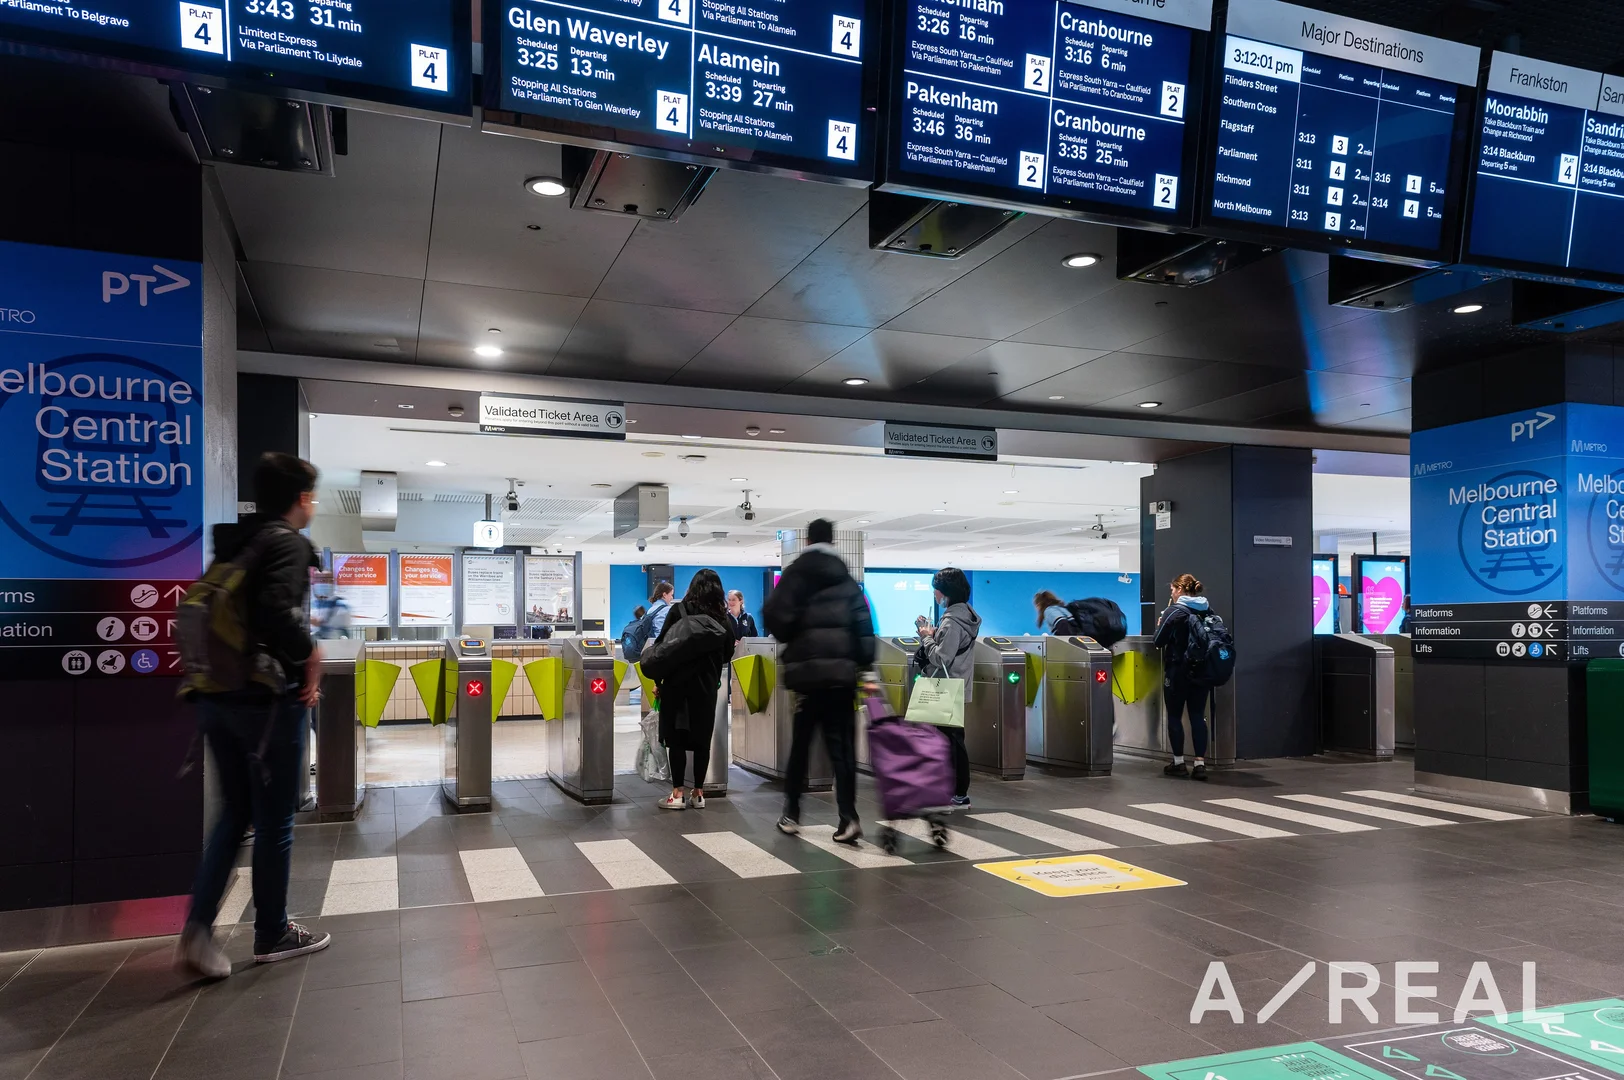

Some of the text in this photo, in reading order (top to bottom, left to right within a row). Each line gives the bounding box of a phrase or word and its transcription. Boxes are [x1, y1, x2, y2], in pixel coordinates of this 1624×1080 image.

[65, 7, 79, 18] To
[82, 10, 129, 27] Belgrave
[189, 8, 213, 20] PLAT
[246, 0, 361, 32] 3:43 31 min
[194, 22, 211, 45] 4
[239, 25, 317, 47] Limited Express
[508, 7, 669, 60] Glen Waverley
[1060, 12, 1152, 46] Cranbourne
[840, 31, 852, 50] 4
[1301, 21, 1424, 63] Major Destinations
[240, 38, 362, 67] Via Parliament To Lilydale
[698, 44, 780, 76] Alamein
[1233, 48, 1293, 74] 3:12:01 pm
[423, 63, 438, 83] 4
[518, 48, 614, 81] 3:25 13 min
[512, 77, 597, 98] Stopping All Stations
[1225, 75, 1277, 94] Flinders Street
[1510, 68, 1567, 93] Frankston
[512, 88, 640, 118] Via Parliament To Glen Waverley
[706, 82, 793, 113] 3:39 27 min
[907, 82, 998, 114] Pakenham
[1223, 95, 1277, 114] Southern Cross
[666, 108, 679, 126] 4
[700, 108, 775, 128] Stopping All Stations
[1486, 98, 1548, 124] Moorabbin
[700, 119, 793, 142] Via Parliament To Alamein
[913, 118, 991, 144] 3:46 36 min
[1054, 110, 1146, 141] Cranbourne
[1221, 120, 1344, 151] Flagstaff 3:13 3
[1483, 127, 1501, 137] Change
[1509, 131, 1533, 142] Richmond
[1484, 117, 1544, 134] Take Blackburn Train and
[836, 135, 848, 154] 4
[1059, 143, 1128, 168] 3:35 25 min
[1483, 146, 1535, 163] 3:14 Blackburn
[1027, 166, 1036, 182] 2
[1053, 166, 1144, 188] Express South Yarra Caulfield
[1219, 146, 1416, 190] Parliament 3:11 4 3:16 1
[1564, 166, 1571, 179] 4
[1053, 176, 1136, 195] Via Parliament To Cranbourne
[1161, 187, 1170, 203] 2
[1216, 173, 1414, 214] Richmond 3:11 4 3:14 4
[1214, 199, 1336, 227] North Melbourne 3:13 3
[0, 362, 192, 404] elbourne
[485, 405, 598, 422] Validated Ticket Area
[35, 406, 191, 445] Central
[889, 432, 928, 442] Validated
[930, 435, 954, 444] Ticket
[957, 437, 976, 446] Area
[1584, 443, 1607, 452] METRO
[42, 449, 191, 485] Station
[1427, 461, 1452, 472] METRO
[1449, 477, 1557, 505] Melbourne
[1482, 499, 1557, 525] Central
[1484, 528, 1557, 549] Station
[1415, 609, 1453, 618] Platforms
[1572, 606, 1607, 615] Platforms
[1415, 626, 1460, 635] Information
[1572, 625, 1614, 635] Information
[1416, 644, 1432, 653] Lifts
[1573, 646, 1589, 655] Lifts
